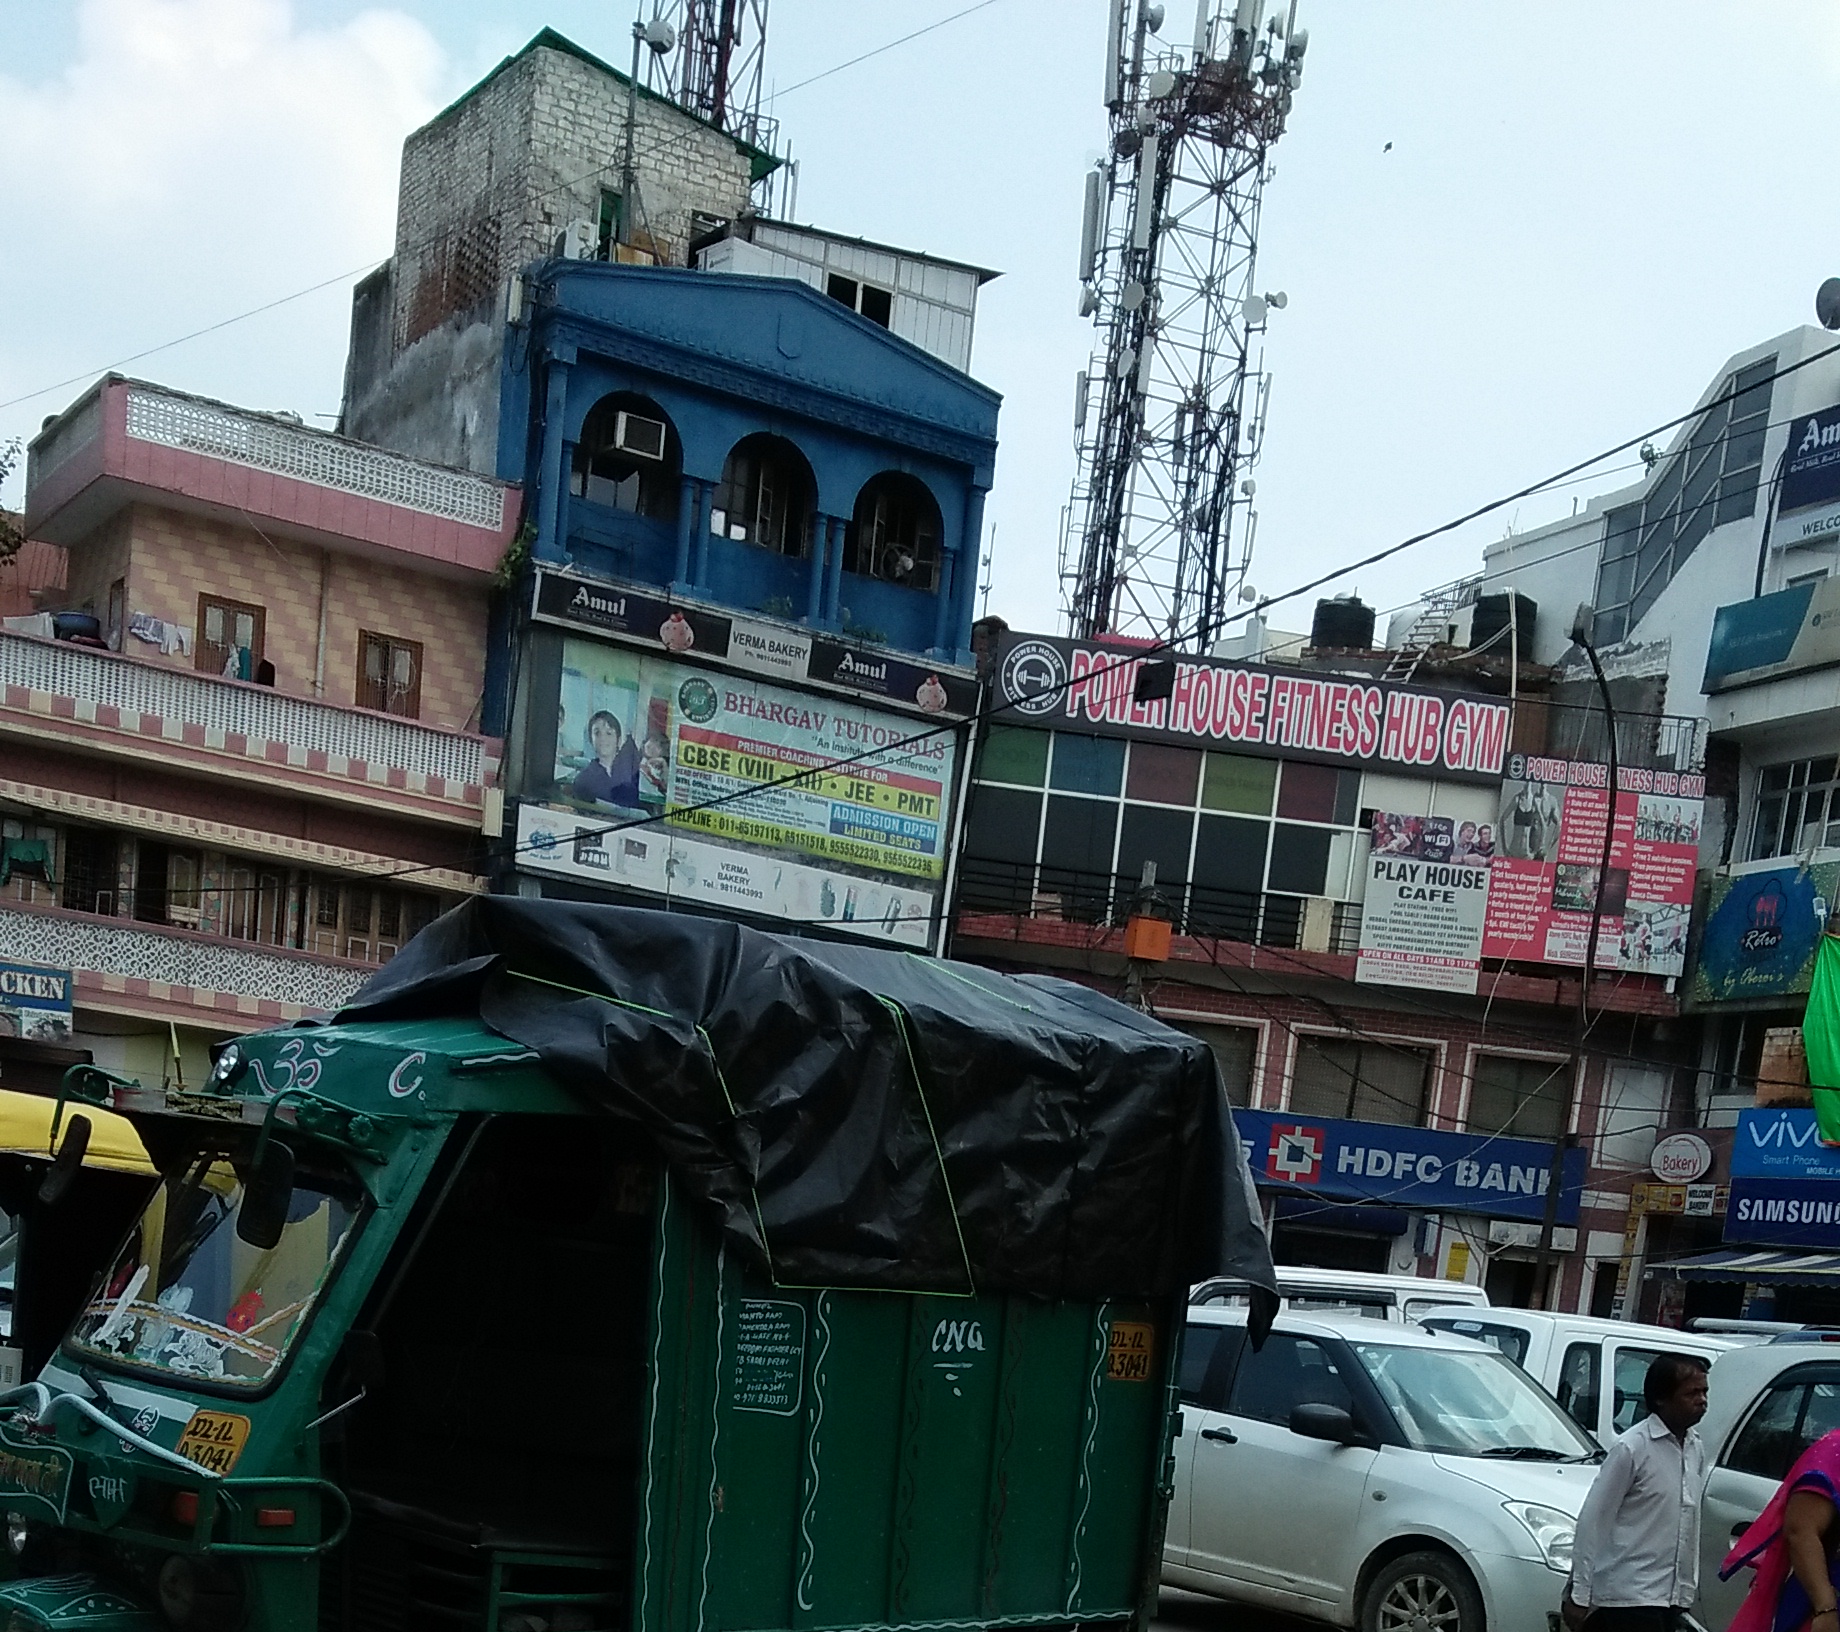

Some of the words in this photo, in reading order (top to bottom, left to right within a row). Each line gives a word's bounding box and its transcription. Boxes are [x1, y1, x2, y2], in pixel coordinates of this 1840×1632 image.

[572, 586, 626, 616] Amul
[733, 631, 766, 650] VERMA
[768, 641, 808, 660] BAKERY
[1010, 645, 1037, 663] POWER
[1039, 646, 1061, 669] HOUSE
[838, 652, 887, 680] Amul
[1007, 686, 1036, 710] FITESS
[1041, 692, 1057, 708] HUB
[724, 692, 827, 732] BHARGAV
[833, 717, 945, 761] TUTORIALS
[1169, 663, 1270, 742] HOUSE
[1266, 675, 1383, 758] FITNESS
[1380, 691, 1445, 766] HUB
[1444, 699, 1510, 774] GYM
[738, 741, 777, 758] PREMIER
[780, 750, 826, 768] COACHING
[828, 759, 869, 777] INSTITUTE
[870, 769, 888, 783] FOR
[831, 742, 865, 757] Institute
[683, 745, 732, 771] CBSE
[738, 756, 775, 781] (VIII
[844, 782, 876, 804] JEE
[897, 792, 935, 816] PMT
[1526, 756, 1568, 783] POWER
[1568, 762, 1609, 788] HOUSE
[1614, 767, 1654, 793] TNESS
[1653, 771, 1679, 796] HUB
[1679, 773, 1706, 798] GYM
[672, 808, 712, 828] HELPLINE
[833, 806, 899, 832] ADMISSION
[903, 819, 936, 839] OPEN
[844, 823, 886, 844] LIMITED
[889, 833, 922, 850] SEATS
[718, 872, 751, 885] BAKERY
[721, 862, 749, 875] VERMA
[1373, 860, 1420, 884] PLAY
[1425, 865, 1486, 890] HOUSE
[1398, 885, 1456, 904] CAFE
[1745, 930, 1777, 951] Retro
[1362, 949, 1381, 958] OPEN
[1382, 951, 1392, 959] ON
[1393, 952, 1405, 960] ALL
[1407, 954, 1424, 963] DAYS
[1446, 958, 1455, 966] TO
[1337, 1145, 1443, 1184] HDFC
[1663, 1154, 1698, 1175] Bakery
[1762, 1154, 1790, 1164] Smart
[1793, 1154, 1820, 1165] Phone
[1806, 1167, 1834, 1175] MOBILE
[932, 1319, 986, 1353] CNG
